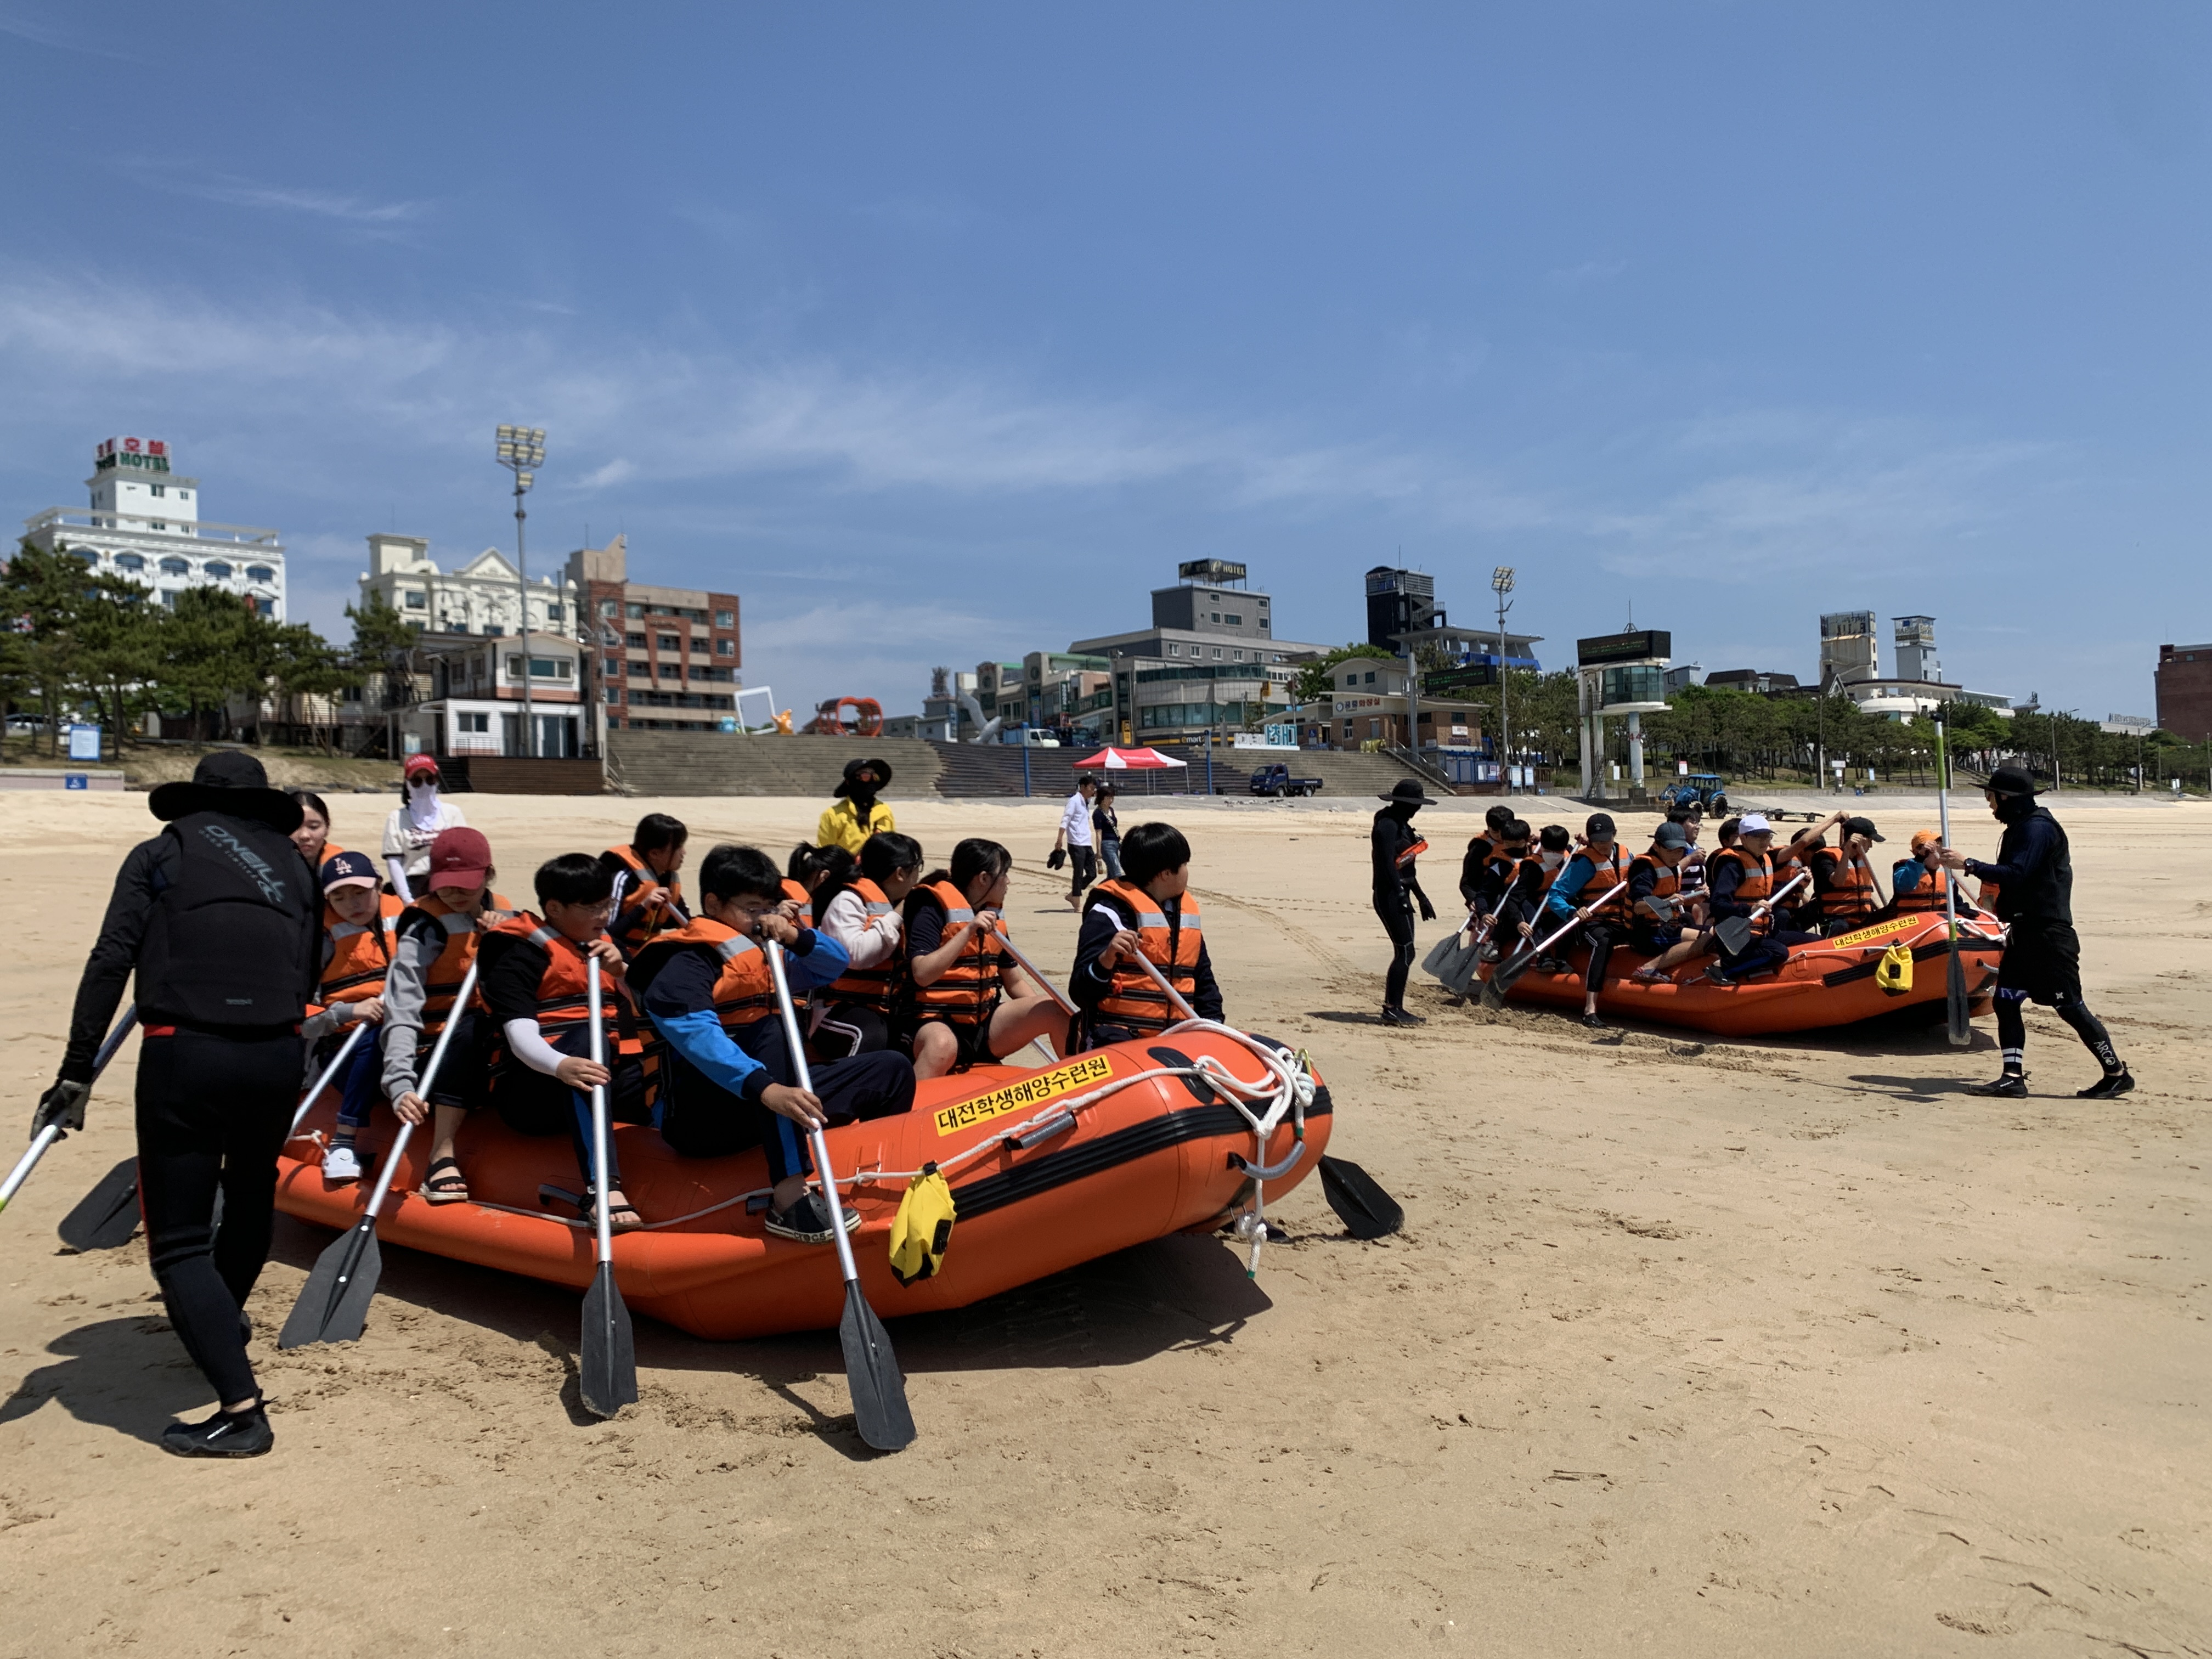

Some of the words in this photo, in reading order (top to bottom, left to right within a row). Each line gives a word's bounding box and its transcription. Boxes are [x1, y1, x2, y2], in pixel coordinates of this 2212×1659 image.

[120, 452, 170, 471] HOTEL
[1223, 564, 1245, 576] HOTEL
[334, 857, 352, 874] LA
[1835, 916, 1917, 947] 대전학생해양수련원
[938, 1057, 1108, 1130] 대전학생해양수련원
